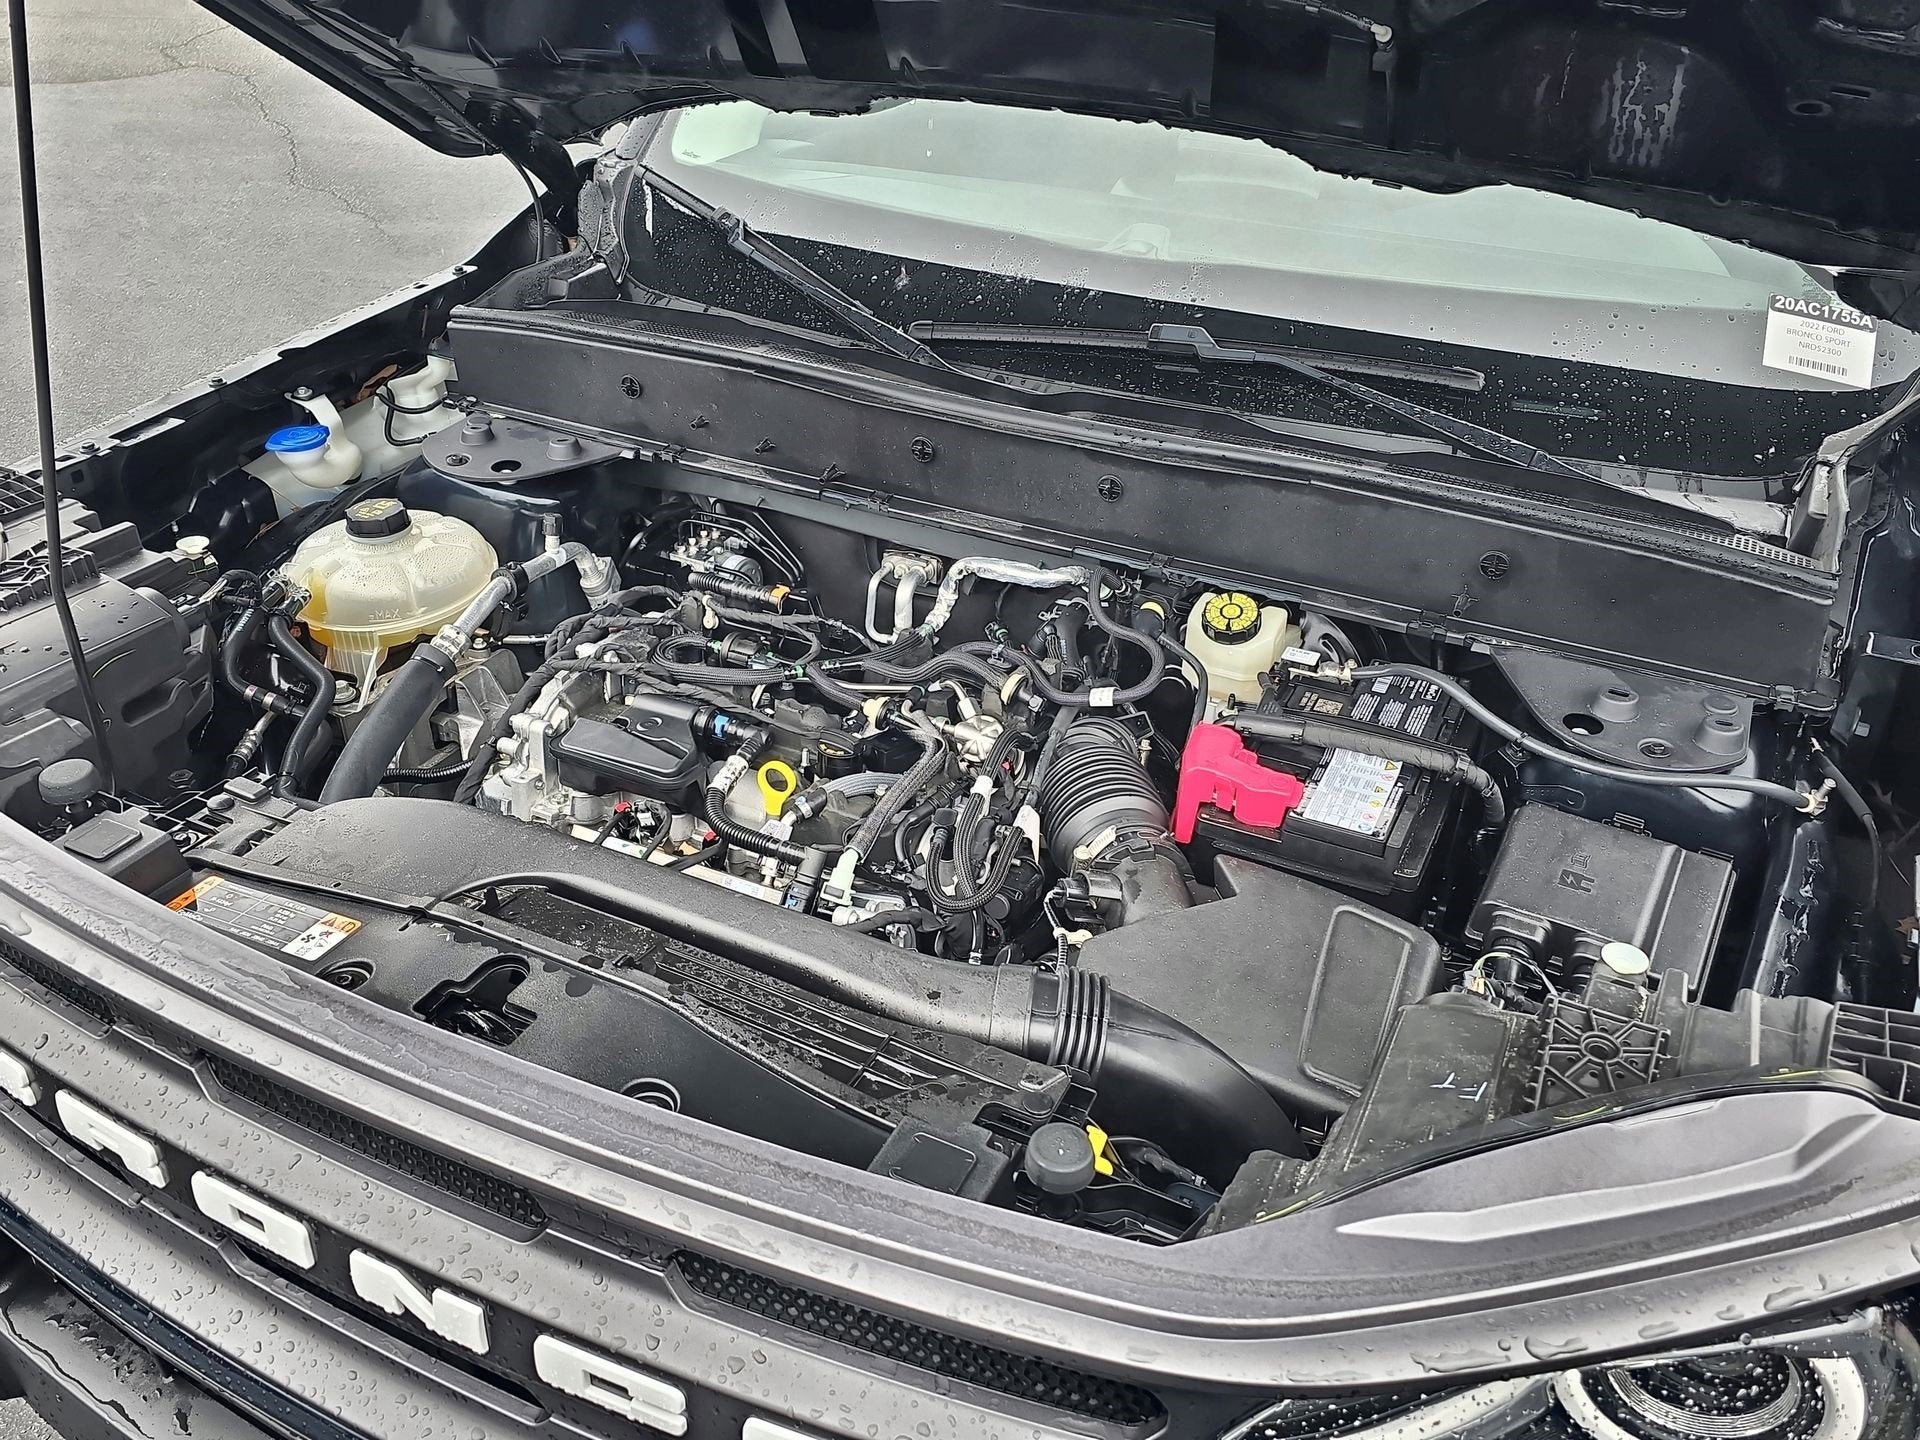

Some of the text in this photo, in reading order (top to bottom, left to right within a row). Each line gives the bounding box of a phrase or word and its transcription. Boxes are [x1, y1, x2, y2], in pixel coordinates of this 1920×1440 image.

[1774, 295, 1873, 329] 20AC1755A
[1799, 320, 1846, 336] 2022 FORD
[1786, 327, 1852, 348] BRONCO SPORT
[1798, 341, 1842, 357] NRD52300
